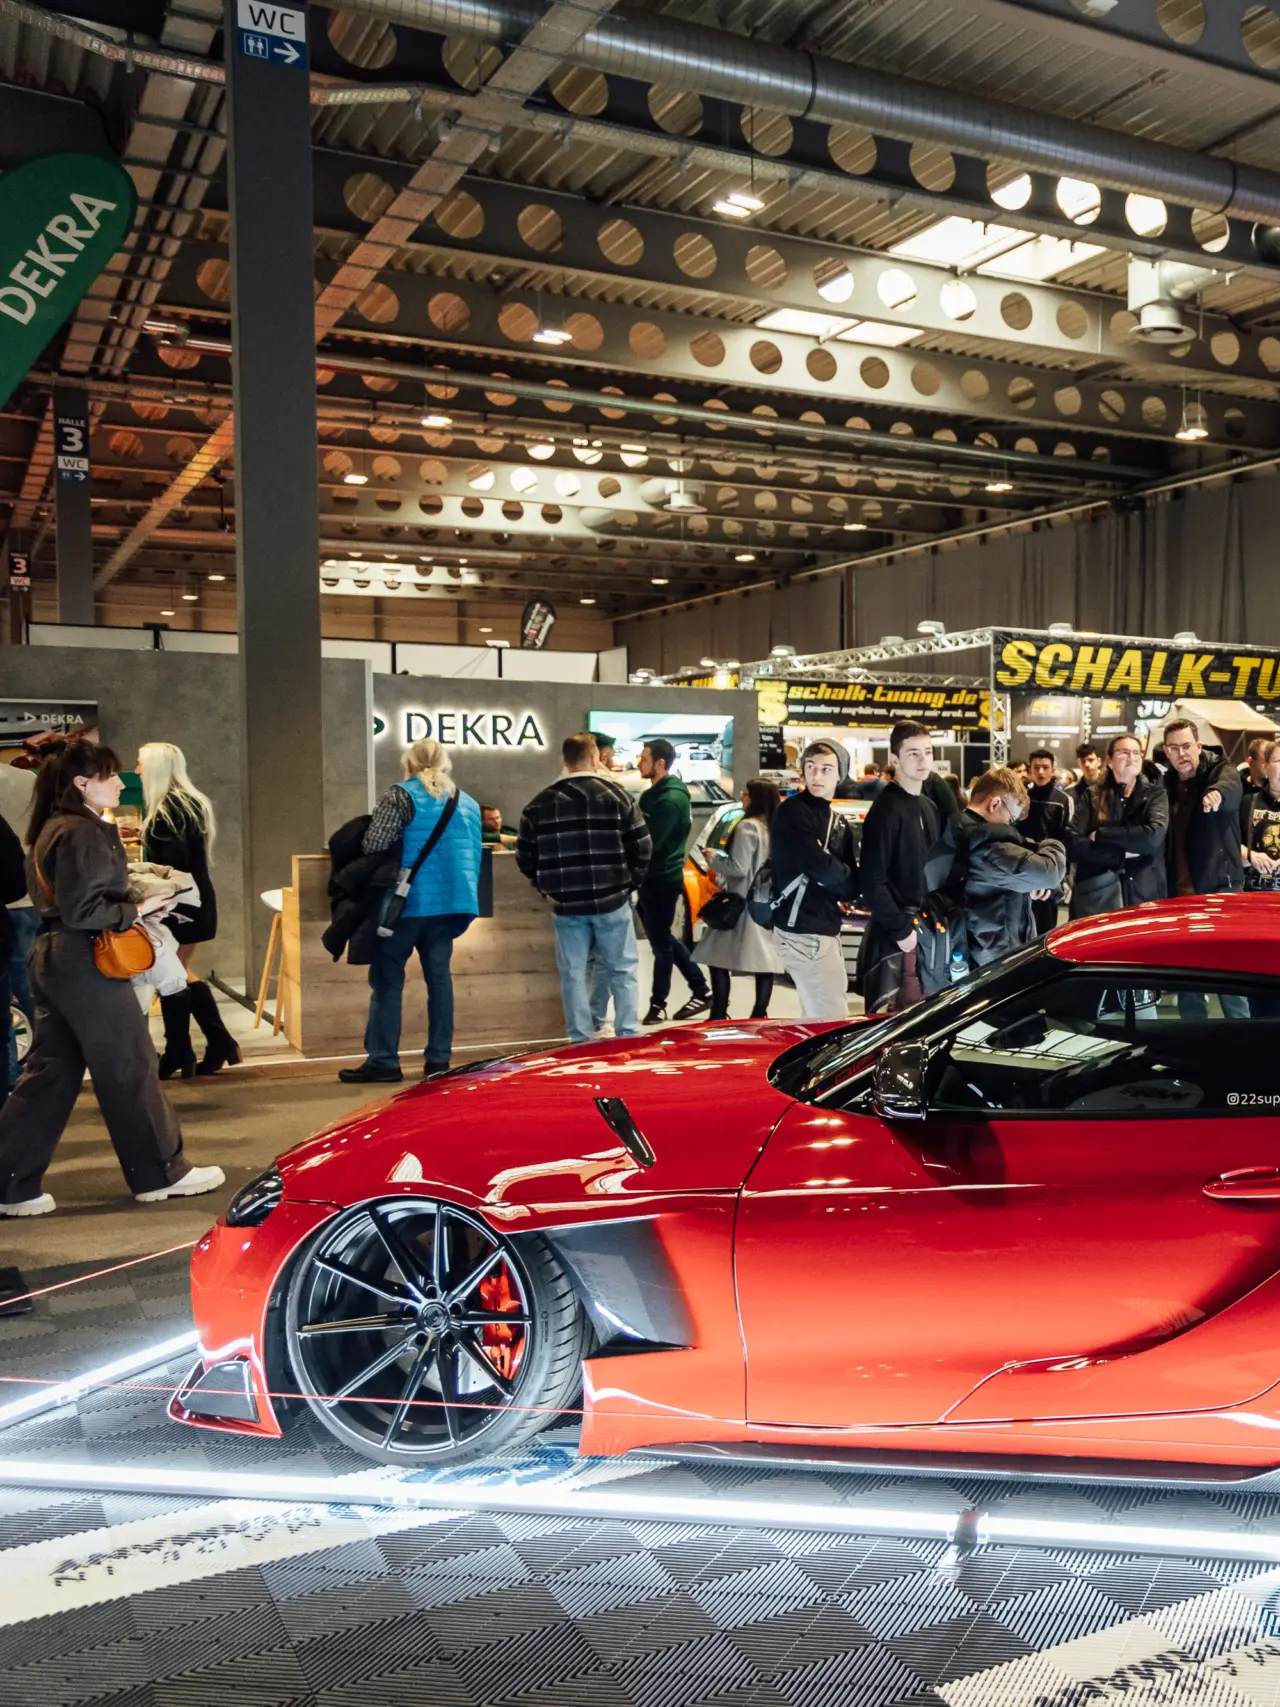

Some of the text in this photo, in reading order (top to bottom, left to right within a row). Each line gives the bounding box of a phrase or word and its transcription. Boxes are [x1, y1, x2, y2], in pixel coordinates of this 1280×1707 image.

[248, 4, 297, 36] WC
[0, 193, 117, 325] DEKRA
[58, 417, 86, 427] HALLE
[61, 427, 83, 452] 3
[63, 458, 84, 469] WC
[13, 558, 28, 574] 3
[788, 683, 978, 708] schalk-tuning.de
[41, 714, 84, 725] DEKRA
[406, 712, 544, 746] DEKRA
